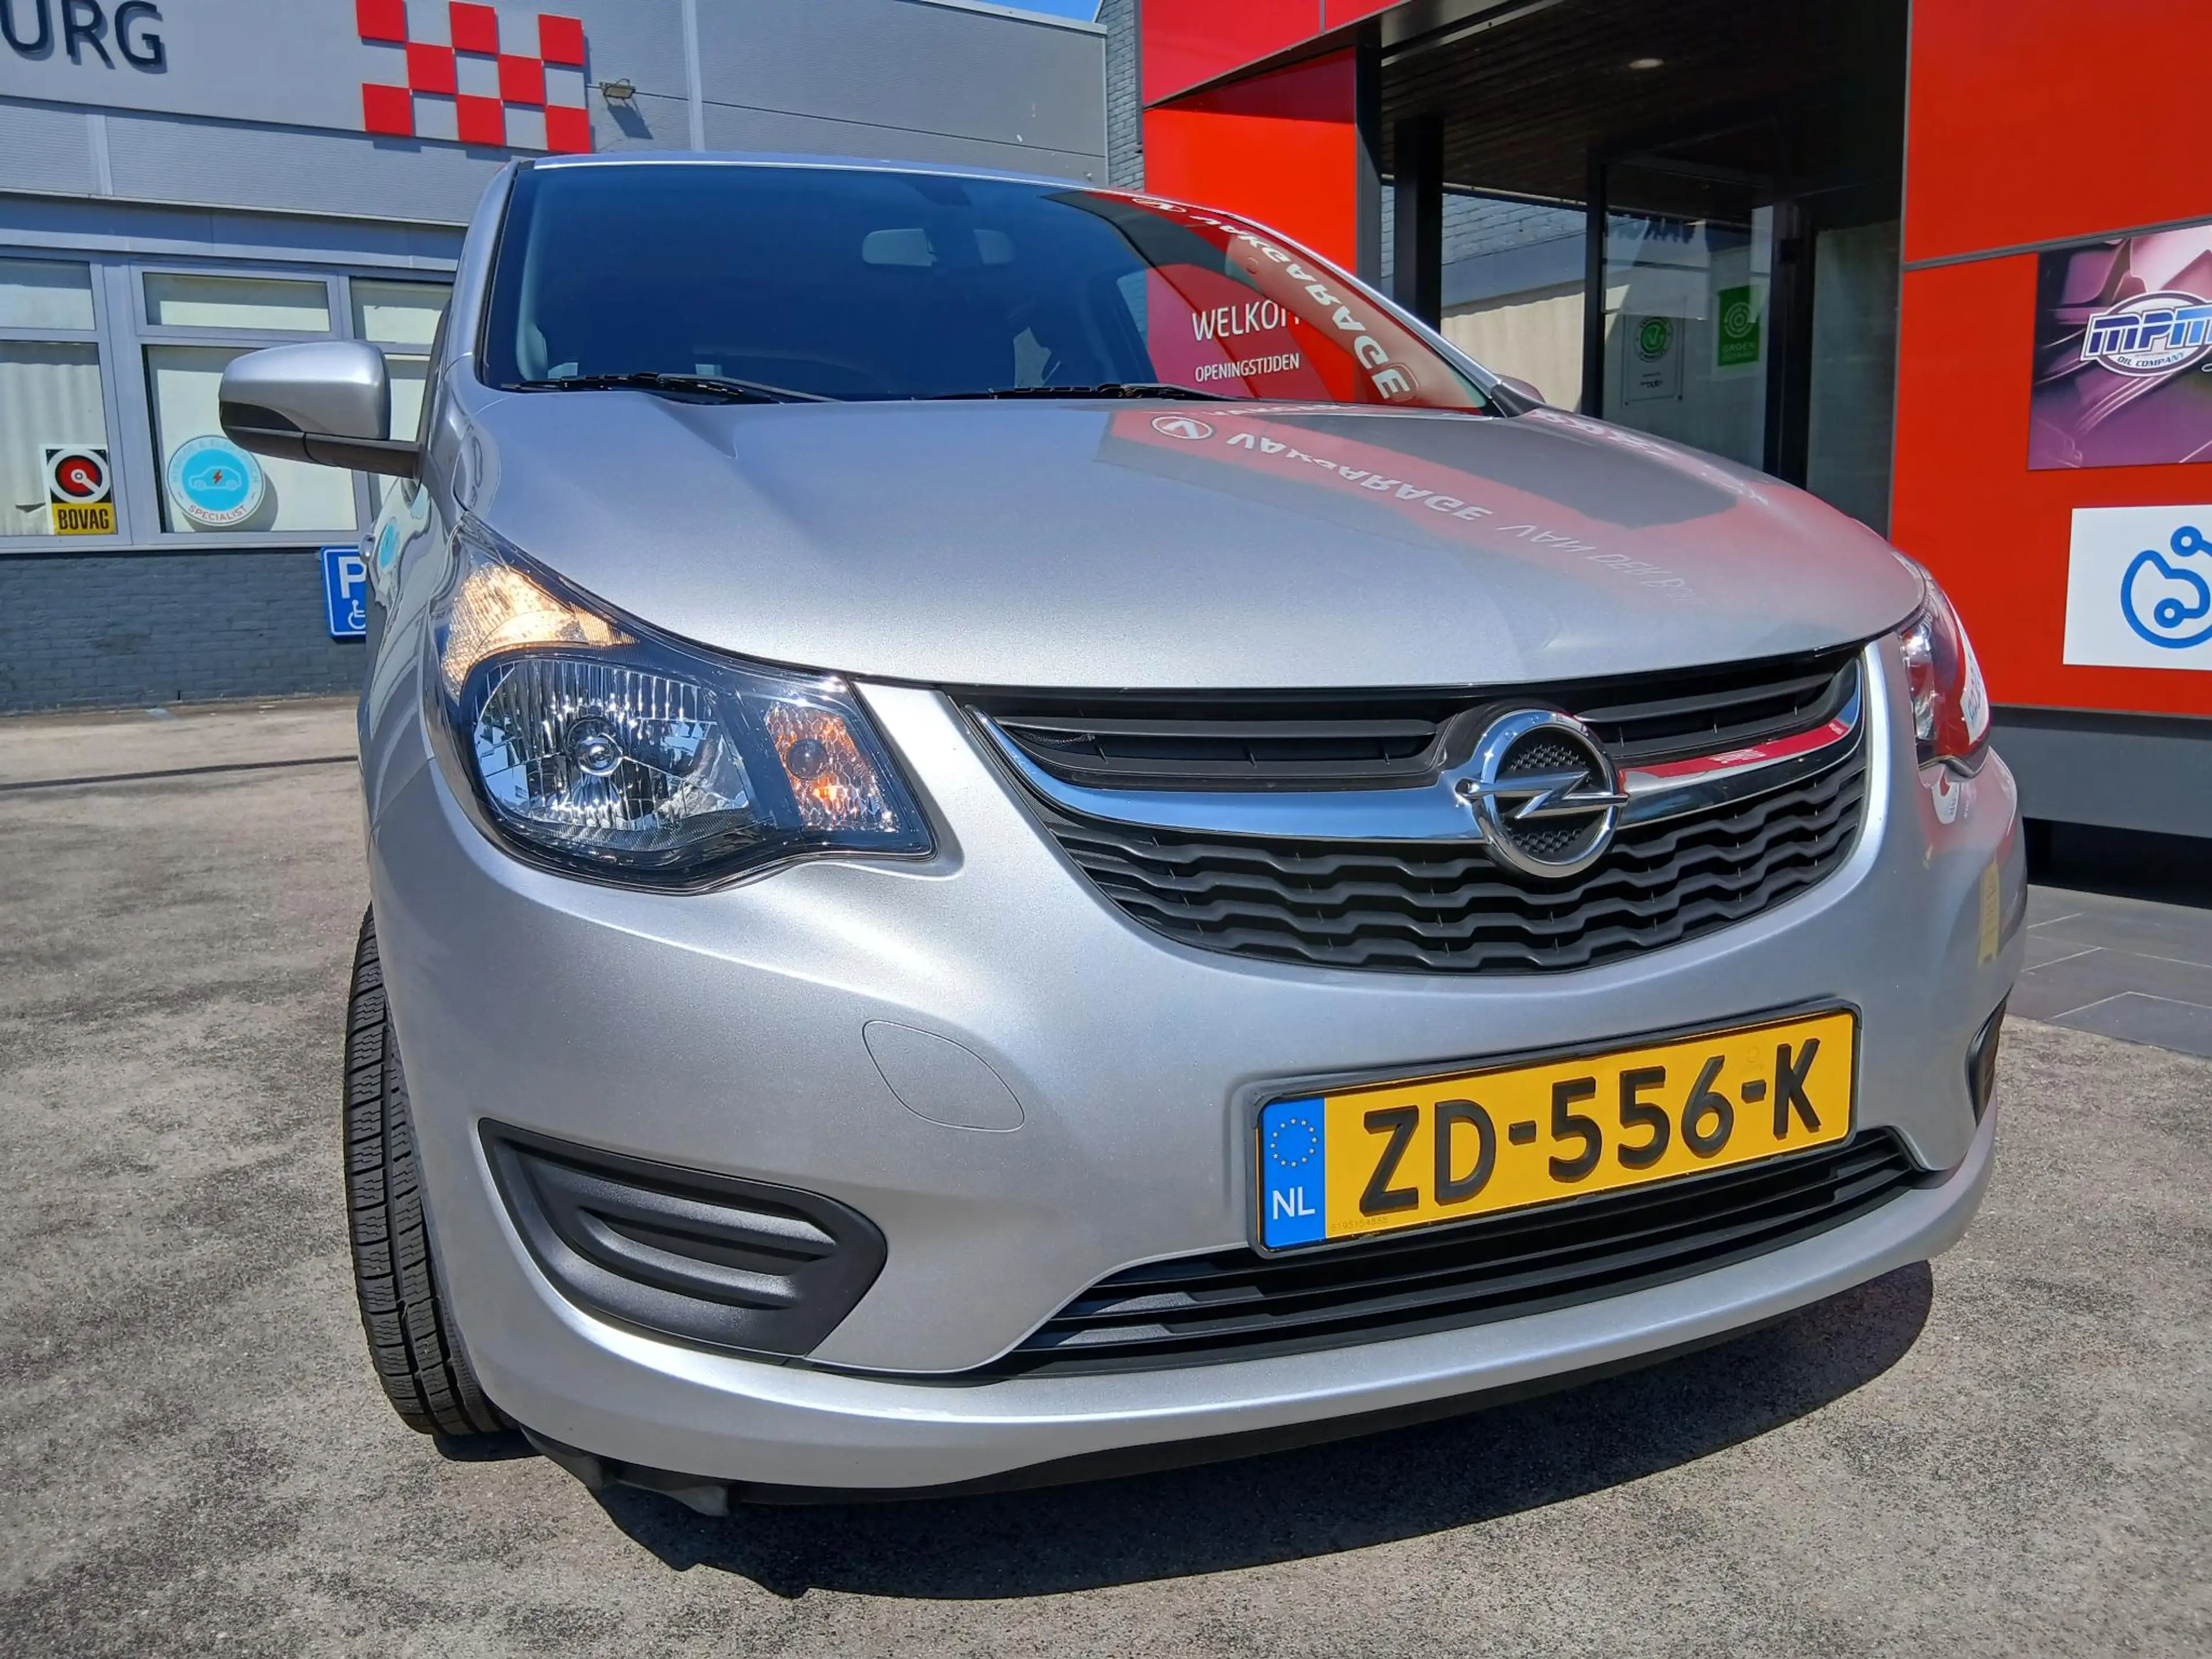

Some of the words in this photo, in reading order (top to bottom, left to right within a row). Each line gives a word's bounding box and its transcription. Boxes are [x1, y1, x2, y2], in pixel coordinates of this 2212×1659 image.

[1195, 353, 1300, 382] OPENINGSTIJDEN
[2118, 356, 2133, 366] OIL
[2135, 351, 2185, 367] COMPANY
[58, 509, 109, 530] BOVAG
[188, 504, 248, 521] SPECIALIST
[338, 556, 367, 599] P
[1358, 1038, 1821, 1217] ZD-556-K
[1272, 1186, 1316, 1220] NL
